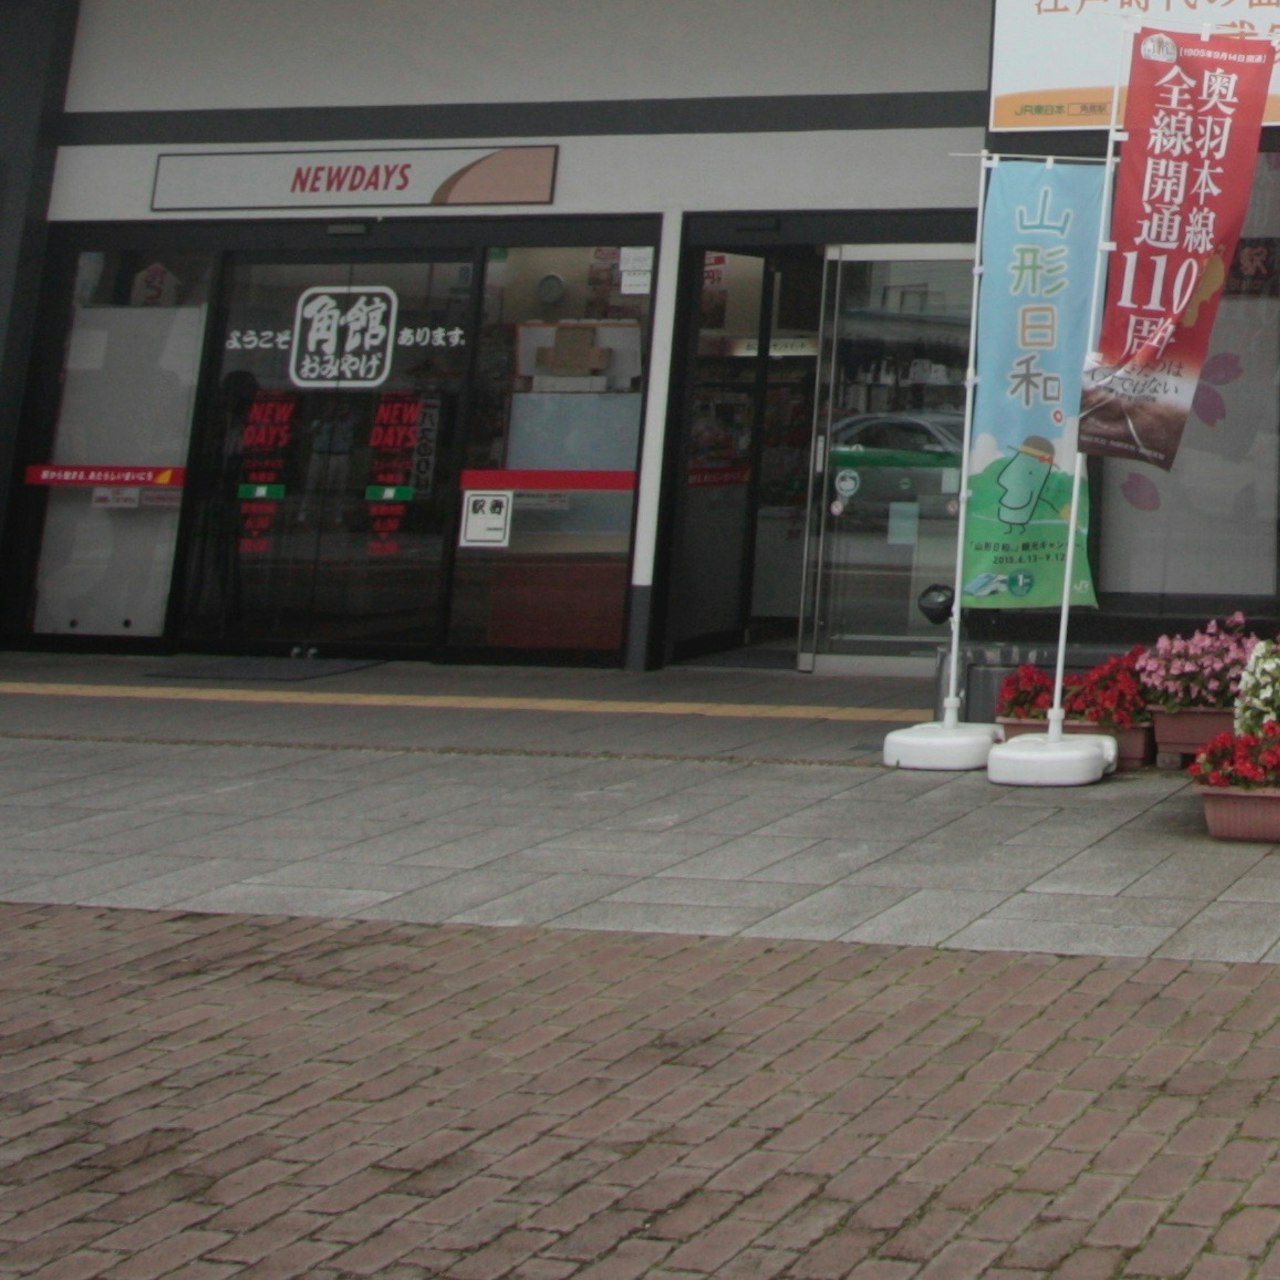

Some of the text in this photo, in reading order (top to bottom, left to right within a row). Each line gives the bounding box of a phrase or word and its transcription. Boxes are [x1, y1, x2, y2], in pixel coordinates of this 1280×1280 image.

[1134, 65, 1197, 250] 全線開通
[1184, 67, 1239, 253] 奥羽本線
[290, 163, 412, 194] NEWDAYS
[1117, 251, 1198, 315] 110
[1009, 188, 1073, 424] 山形日和。
[225, 295, 388, 354] ようこそ 角館
[300, 354, 382, 380] おみやげ
[250, 402, 296, 421] NEW
[376, 402, 423, 423] NEW
[242, 424, 290, 448] DAYS
[369, 425, 418, 448] DAYS
